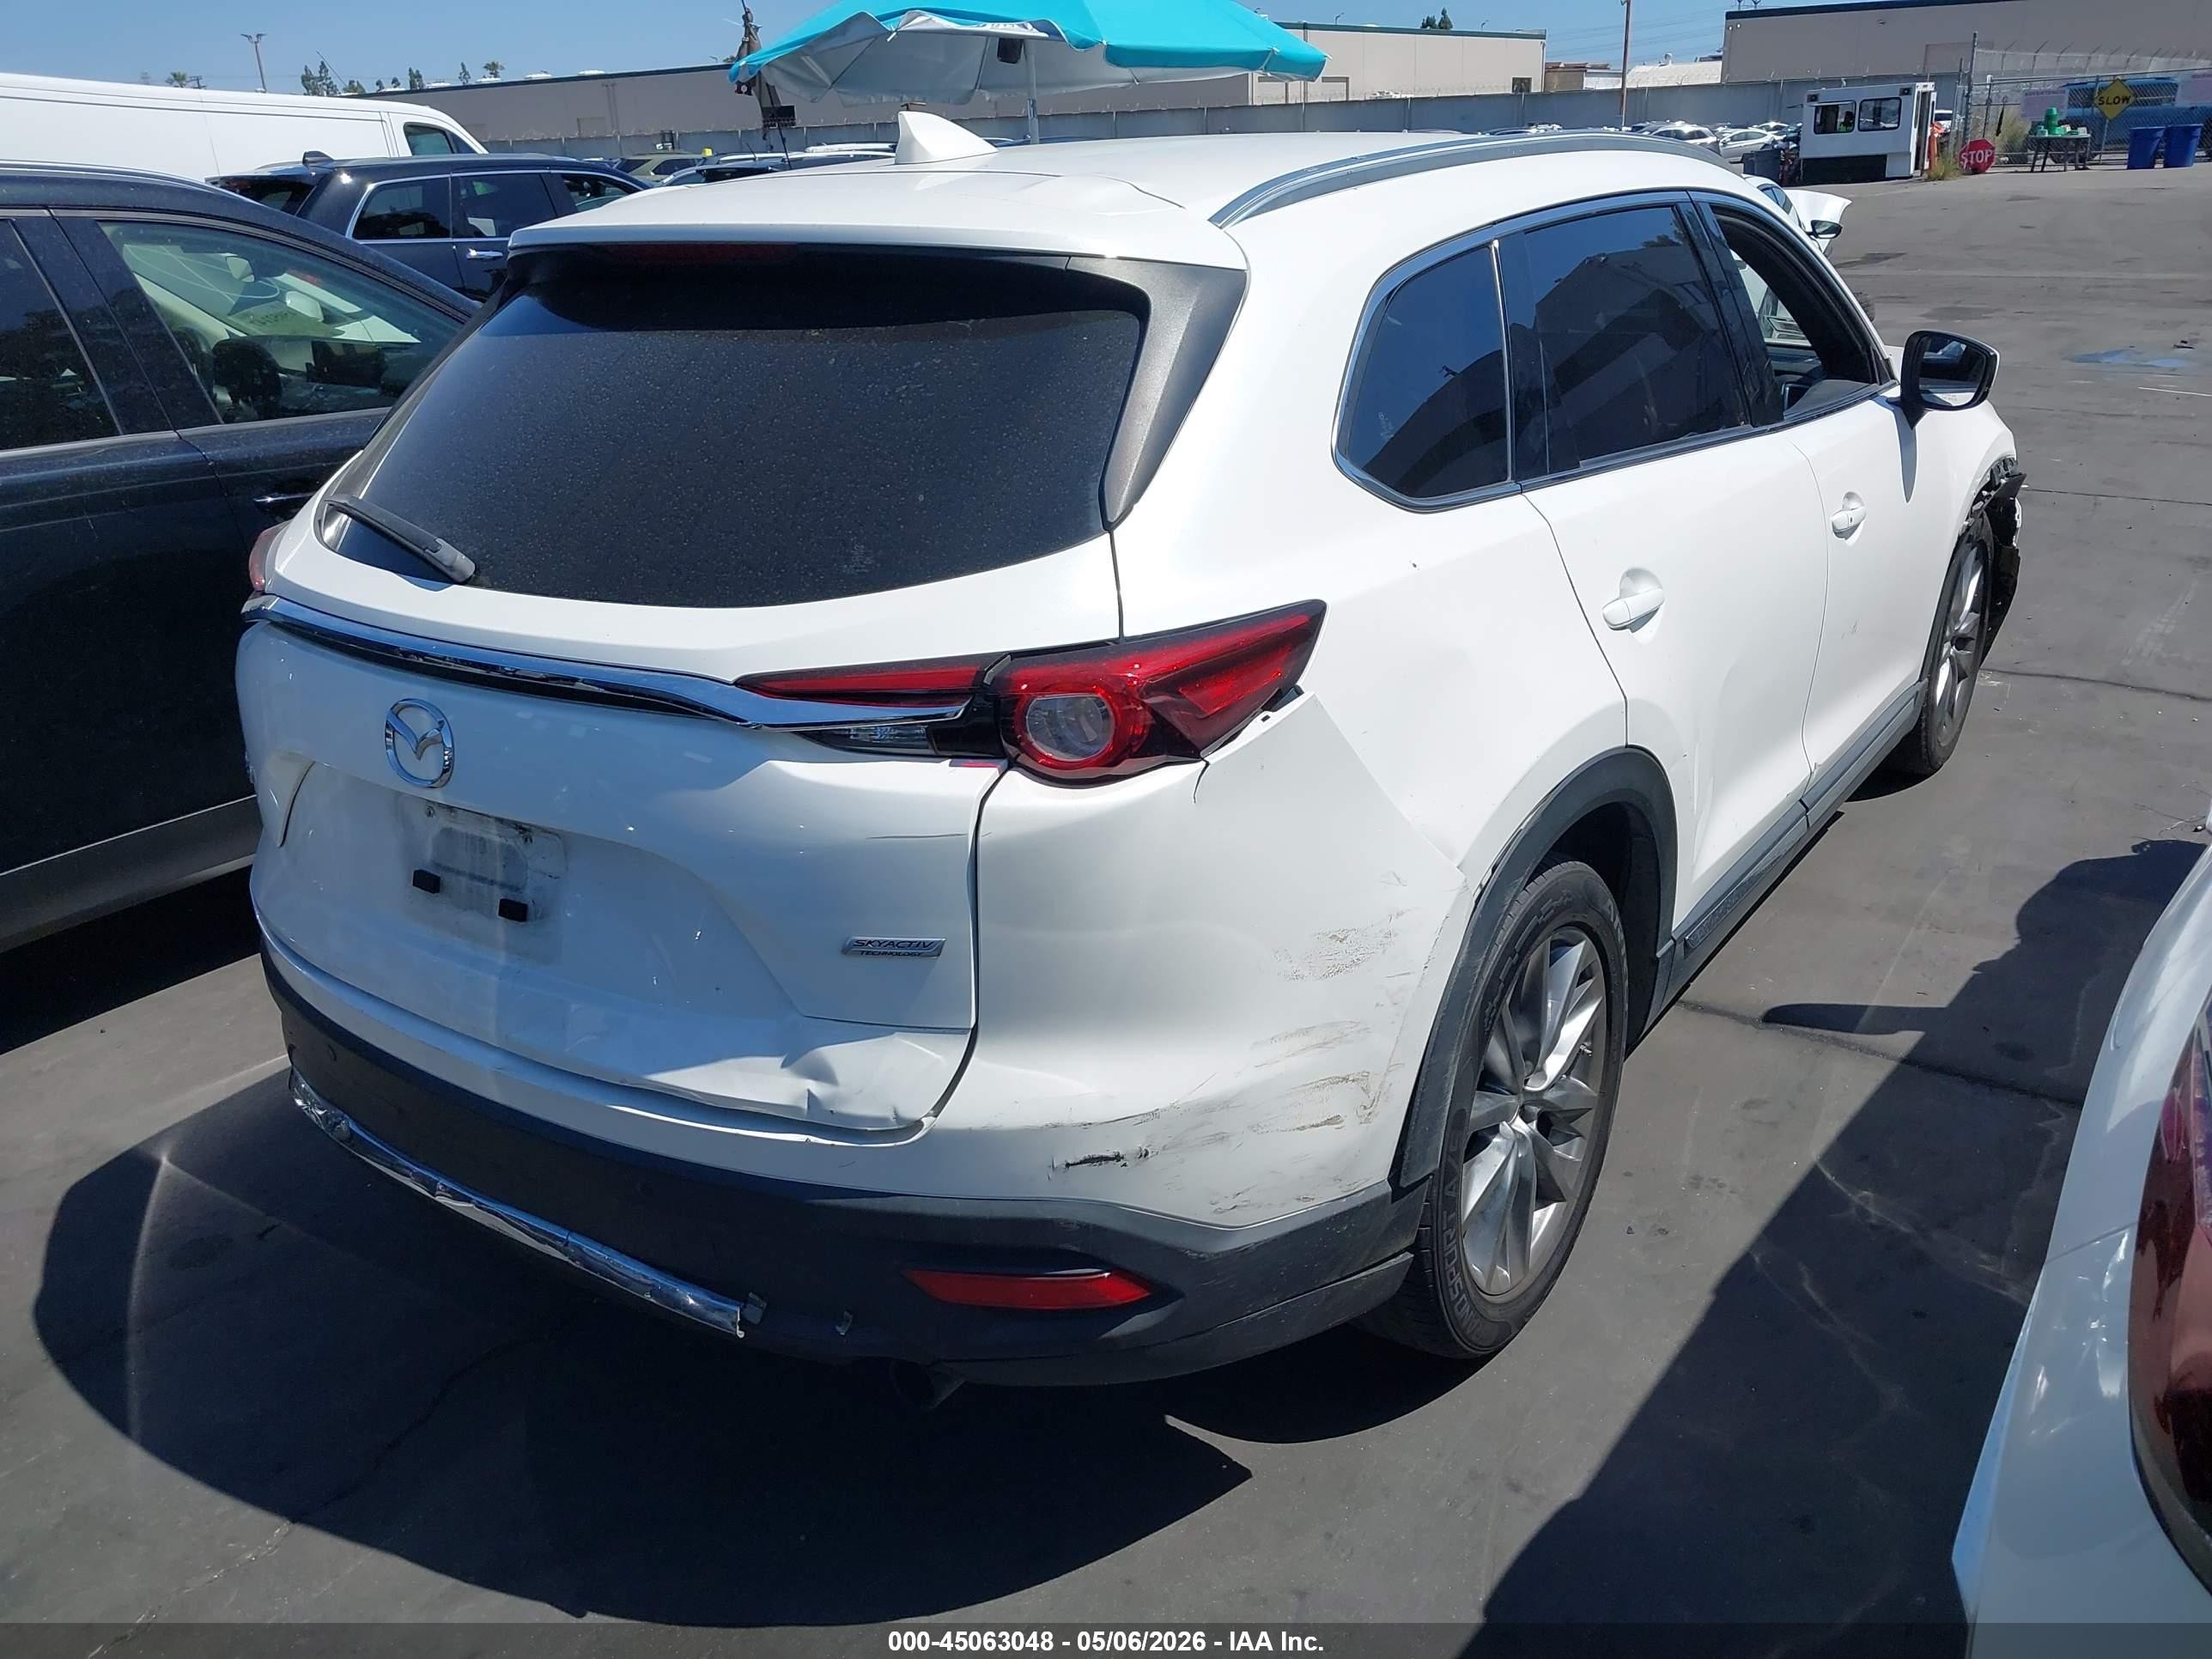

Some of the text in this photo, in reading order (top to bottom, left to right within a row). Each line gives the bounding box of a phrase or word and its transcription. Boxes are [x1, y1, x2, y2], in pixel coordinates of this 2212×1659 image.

[2098, 95, 2130, 106] SLOW
[1961, 149, 1992, 165] STOP
[853, 939, 935, 949] SKYACTIV
[1443, 1209, 1466, 1301] SPORT
